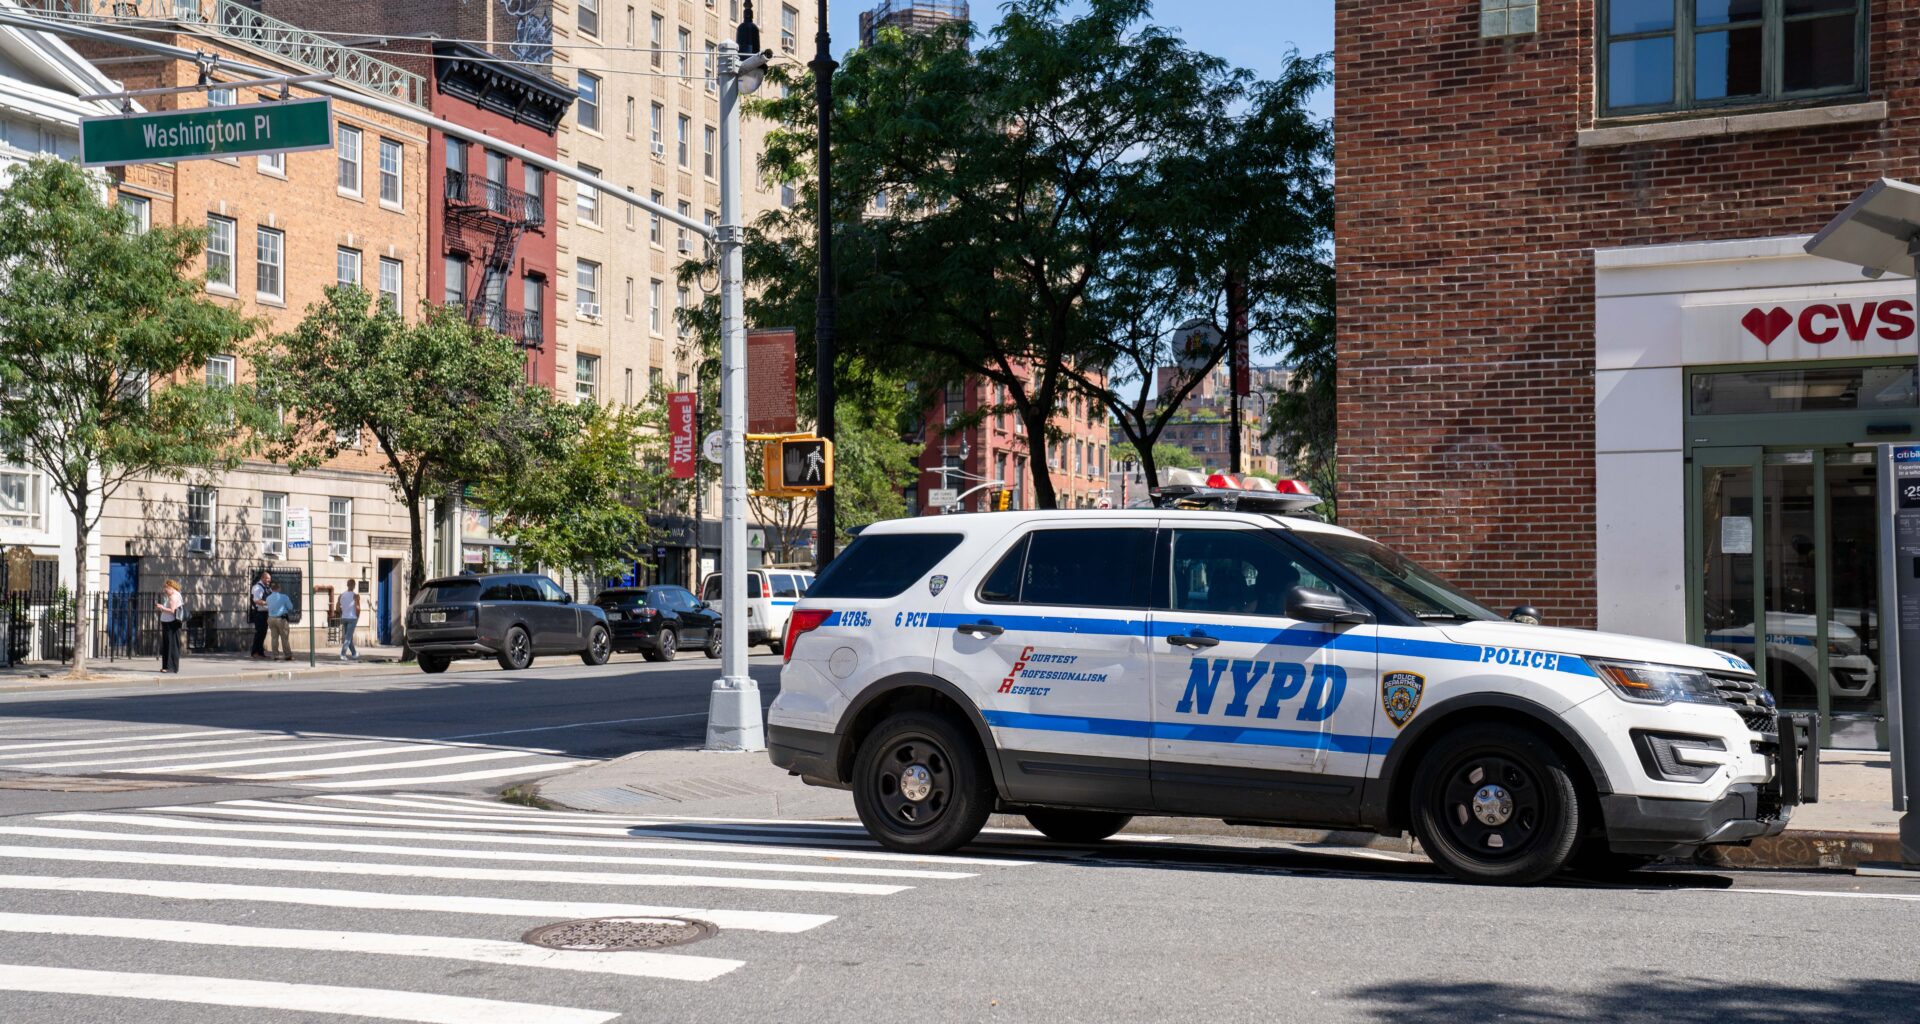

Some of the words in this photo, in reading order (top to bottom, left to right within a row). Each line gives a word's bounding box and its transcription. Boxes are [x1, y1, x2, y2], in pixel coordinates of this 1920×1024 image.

[143, 119, 246, 151] Washington
[254, 114, 271, 140] Pl
[1798, 299, 1915, 344] CVS
[682, 405, 692, 463] VILLAGE
[674, 436, 683, 463] THE
[1896, 450, 1909, 459] citi
[672, 527, 685, 537] WAX
[841, 611, 867, 627] 4785
[895, 612, 903, 627] 6
[904, 612, 927, 627] PCT
[1020, 646, 1078, 664] COURTESY
[1482, 646, 1557, 671] POLICE
[1009, 661, 1108, 682] PROFESSIONALISM
[997, 678, 1051, 696] RESPECT
[1175, 657, 1348, 722] NYPD
[1384, 680, 1421, 690] DEPARTMENT
